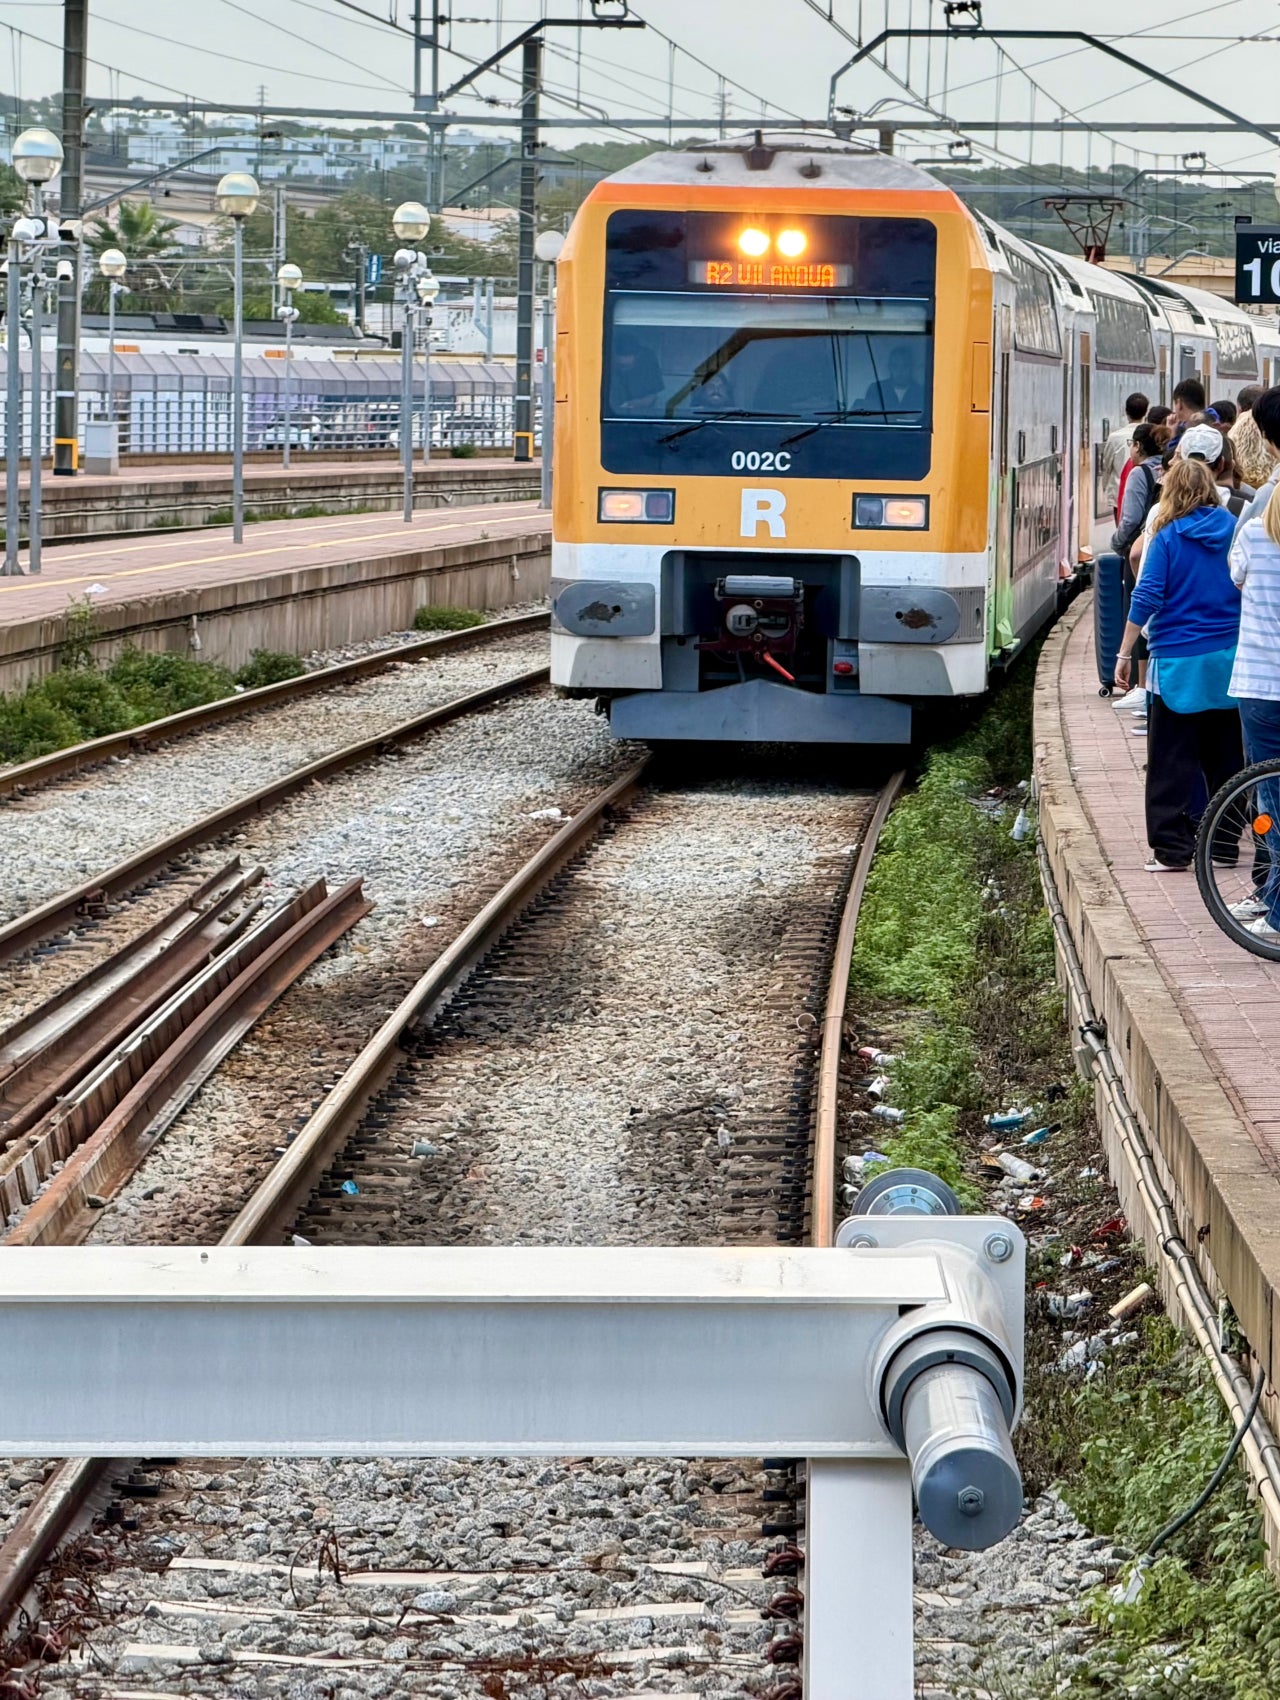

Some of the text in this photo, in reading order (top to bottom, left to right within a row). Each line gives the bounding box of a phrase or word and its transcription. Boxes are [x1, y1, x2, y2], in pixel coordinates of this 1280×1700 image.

[707, 262, 835, 288] R2 VILANOVA
[731, 450, 792, 471] 002C
[740, 488, 787, 538] R
